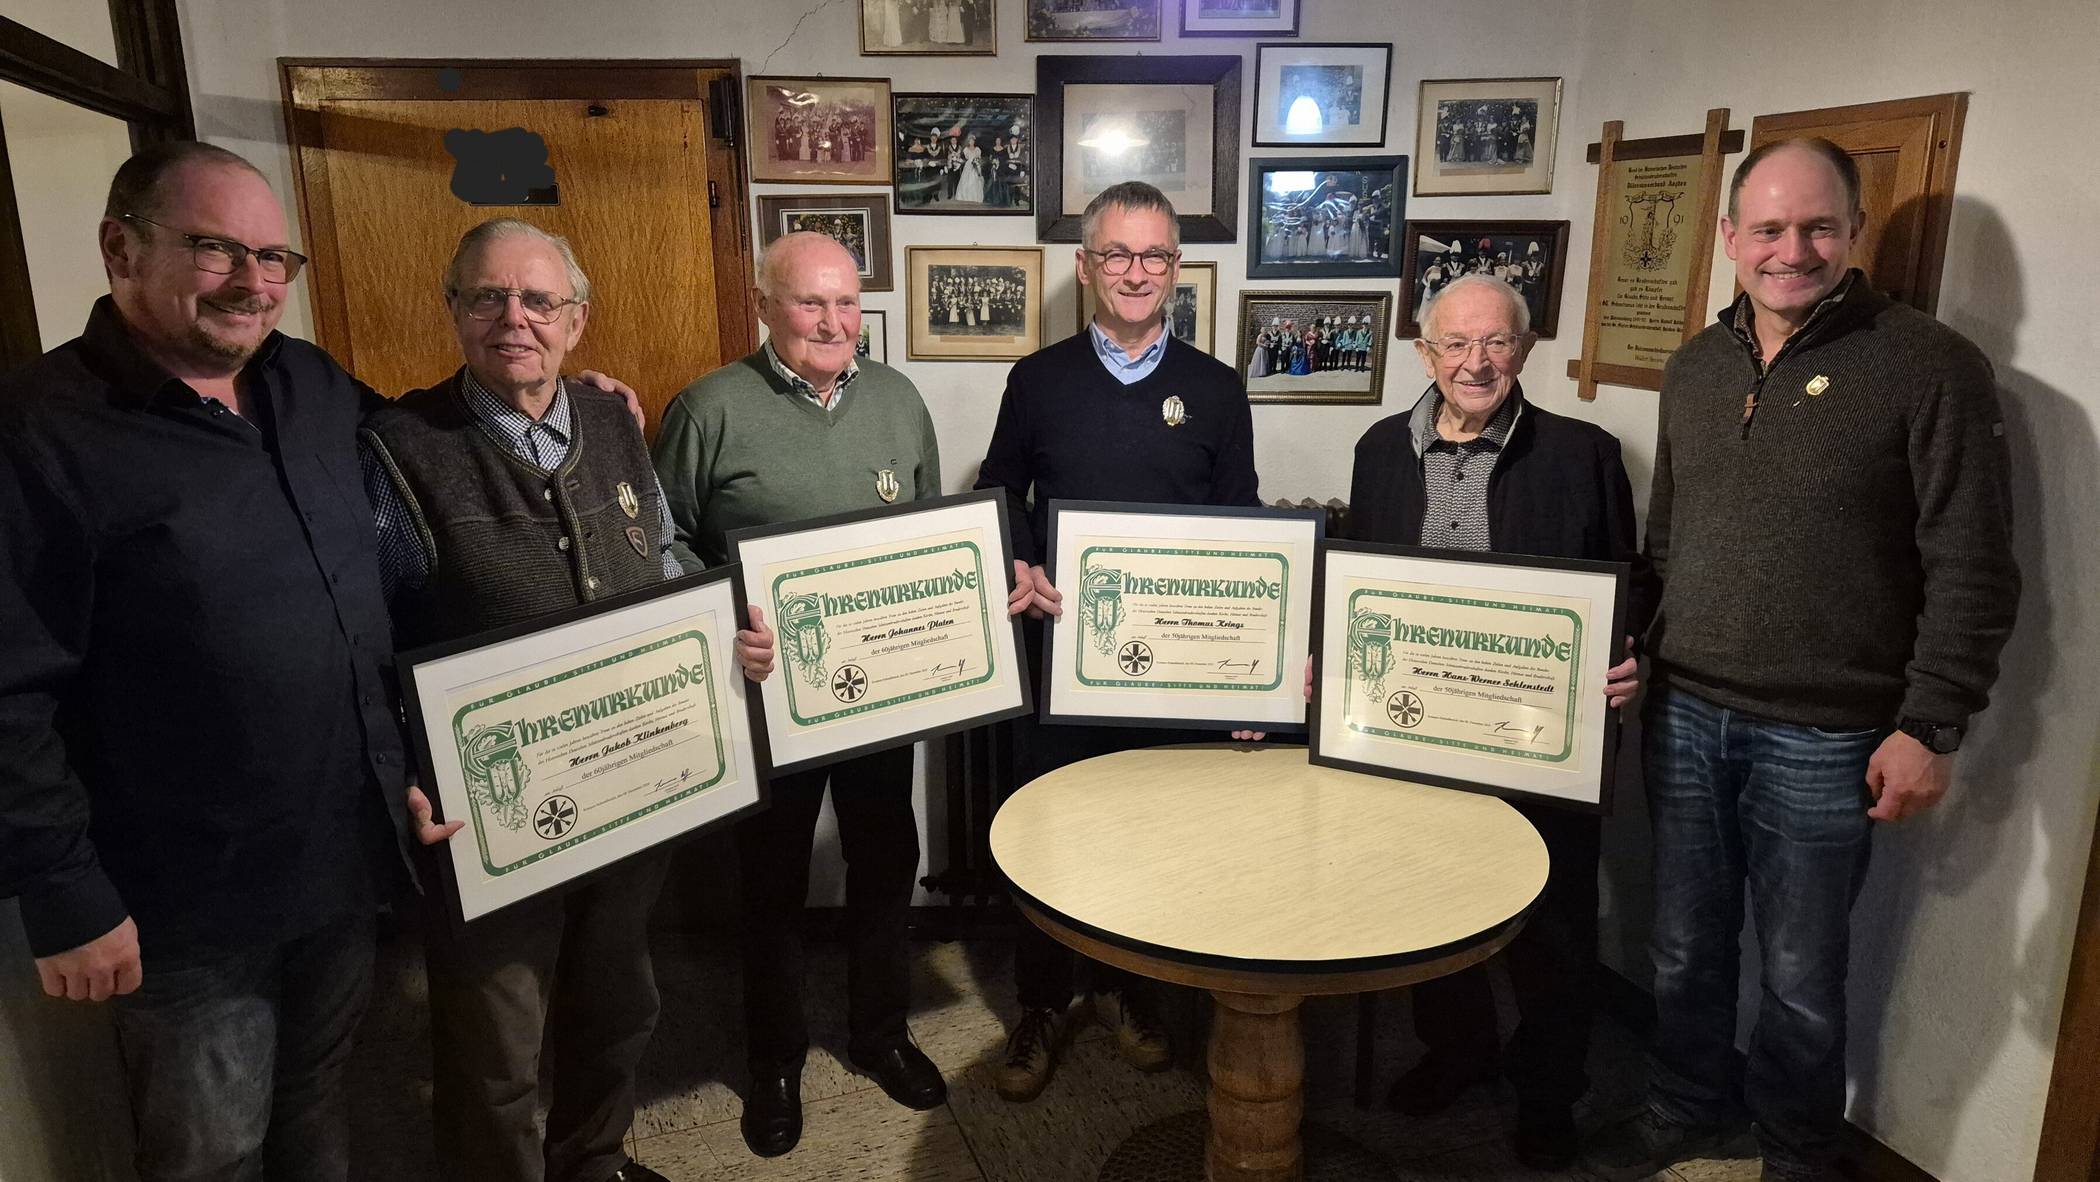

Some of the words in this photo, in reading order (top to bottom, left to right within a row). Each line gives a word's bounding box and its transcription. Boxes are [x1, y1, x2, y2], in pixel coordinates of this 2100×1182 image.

[861, 634, 886, 642] Herrn
[888, 625, 925, 638] Johannes
[927, 619, 954, 629] Platen
[611, 651, 633, 663] UND
[1413, 667, 1438, 677] Herrn
[1442, 671, 1501, 685] Hans-Werner
[569, 752, 598, 767] Herrn
[601, 738, 631, 756] Jakob
[634, 719, 688, 743] Klinkenberg
